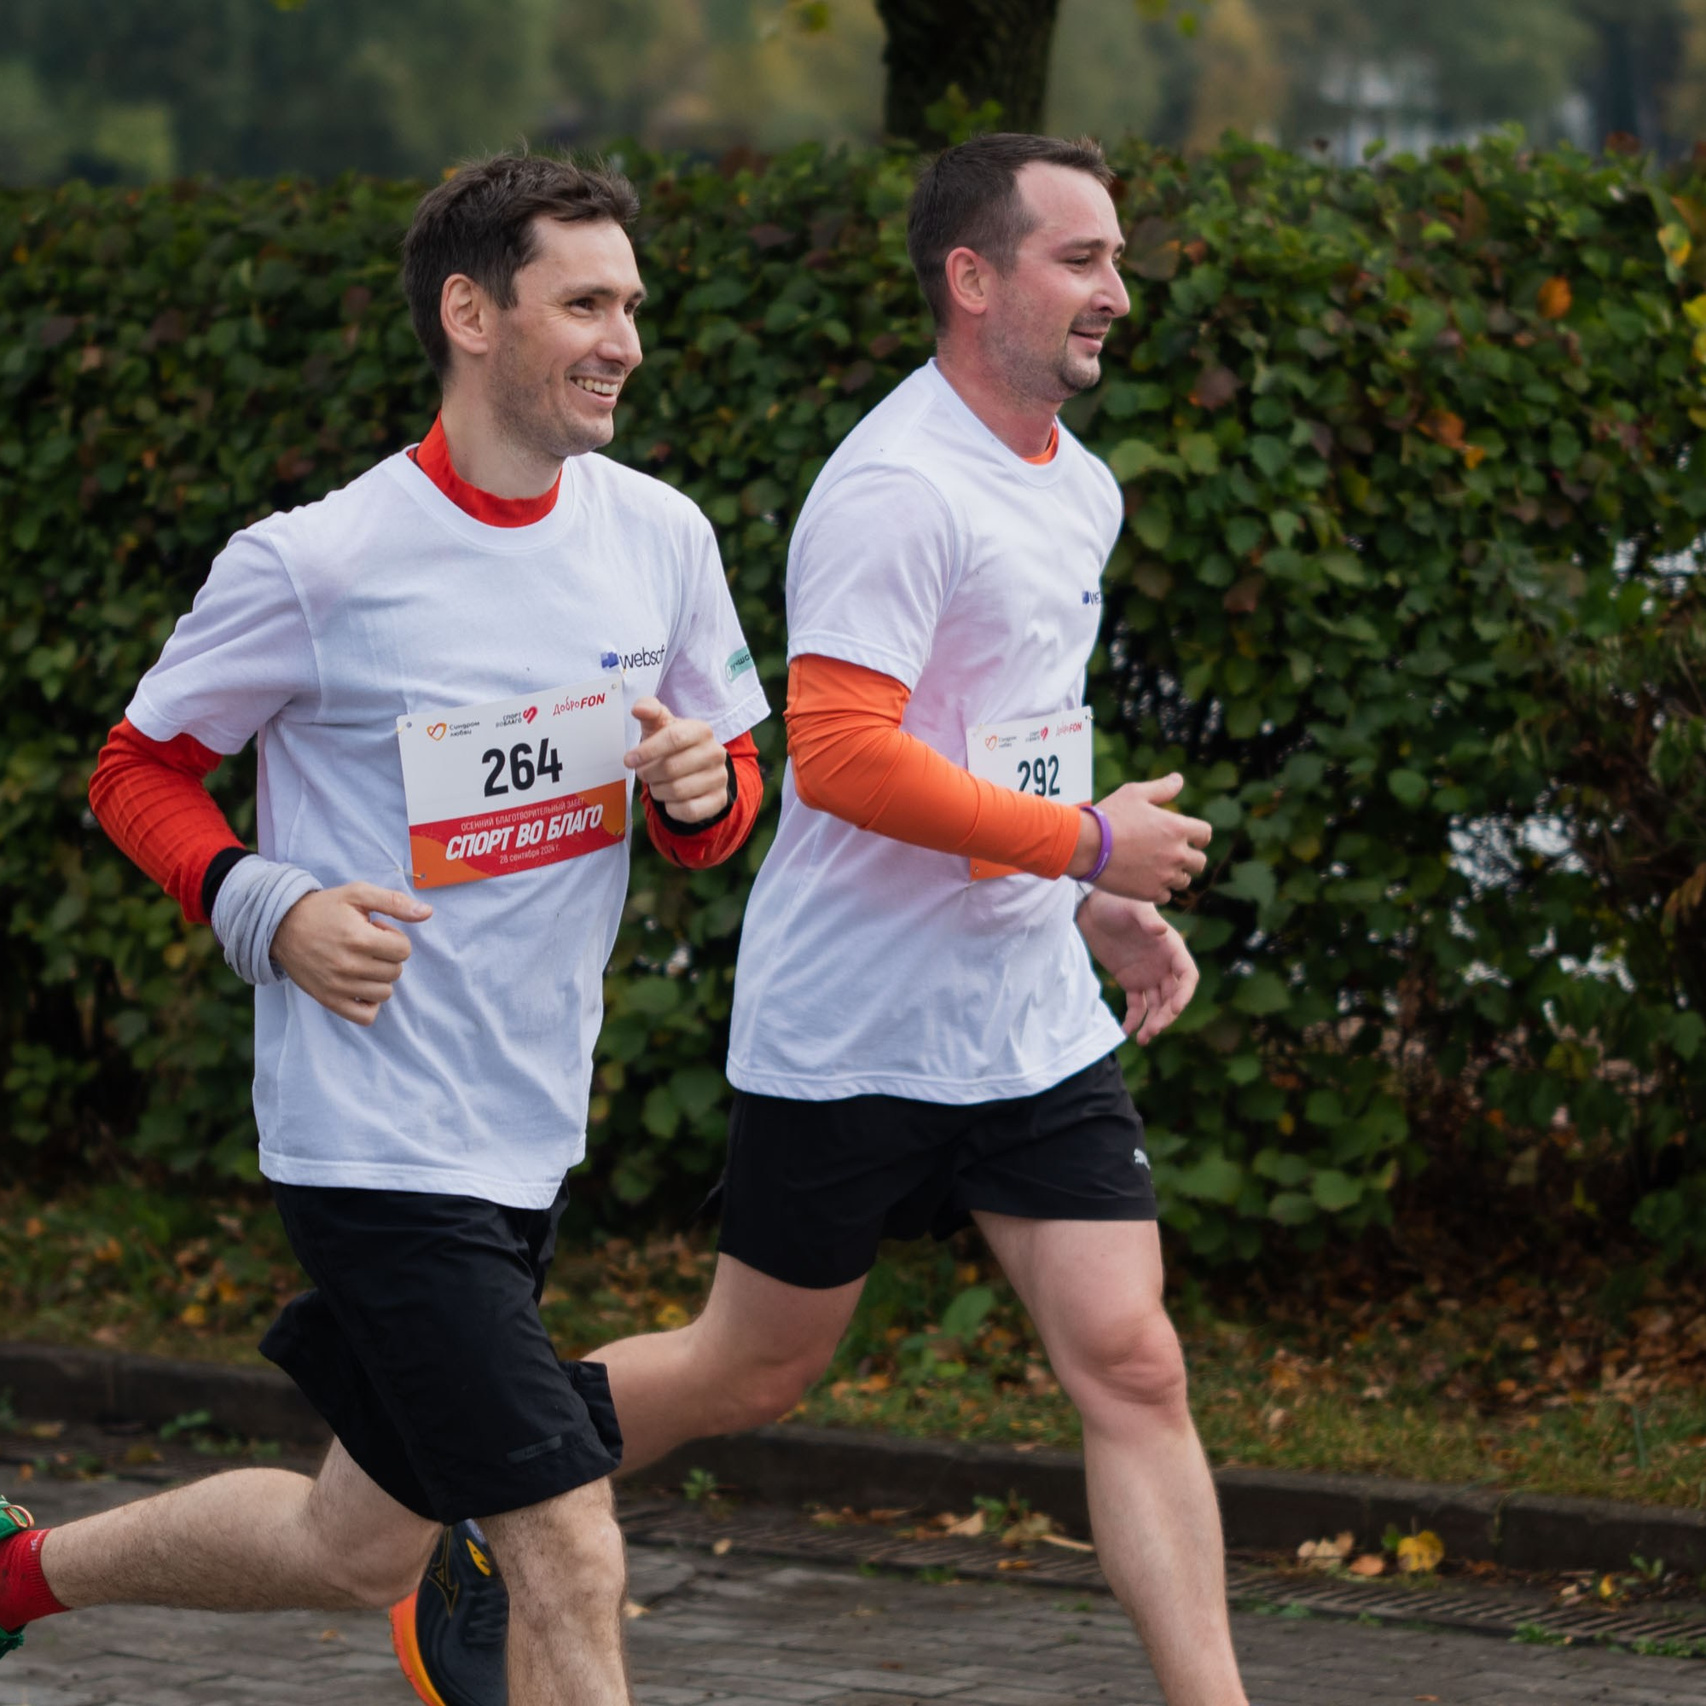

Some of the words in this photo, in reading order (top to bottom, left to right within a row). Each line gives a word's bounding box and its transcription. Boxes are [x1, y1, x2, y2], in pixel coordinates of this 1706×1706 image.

[482, 737, 563, 797] 264
[1017, 754, 1060, 798] 292
[445, 825, 515, 861] СПОРТ
[515, 819, 544, 848] ВО
[546, 803, 604, 842] БЛАГО
[461, 817, 494, 831] ОСЕННИЙ
[495, 803, 566, 825] БЛАГОТВОРИТЕЛЬНЫЙ
[500, 854, 509, 864] 28
[509, 849, 540, 862] сентября
